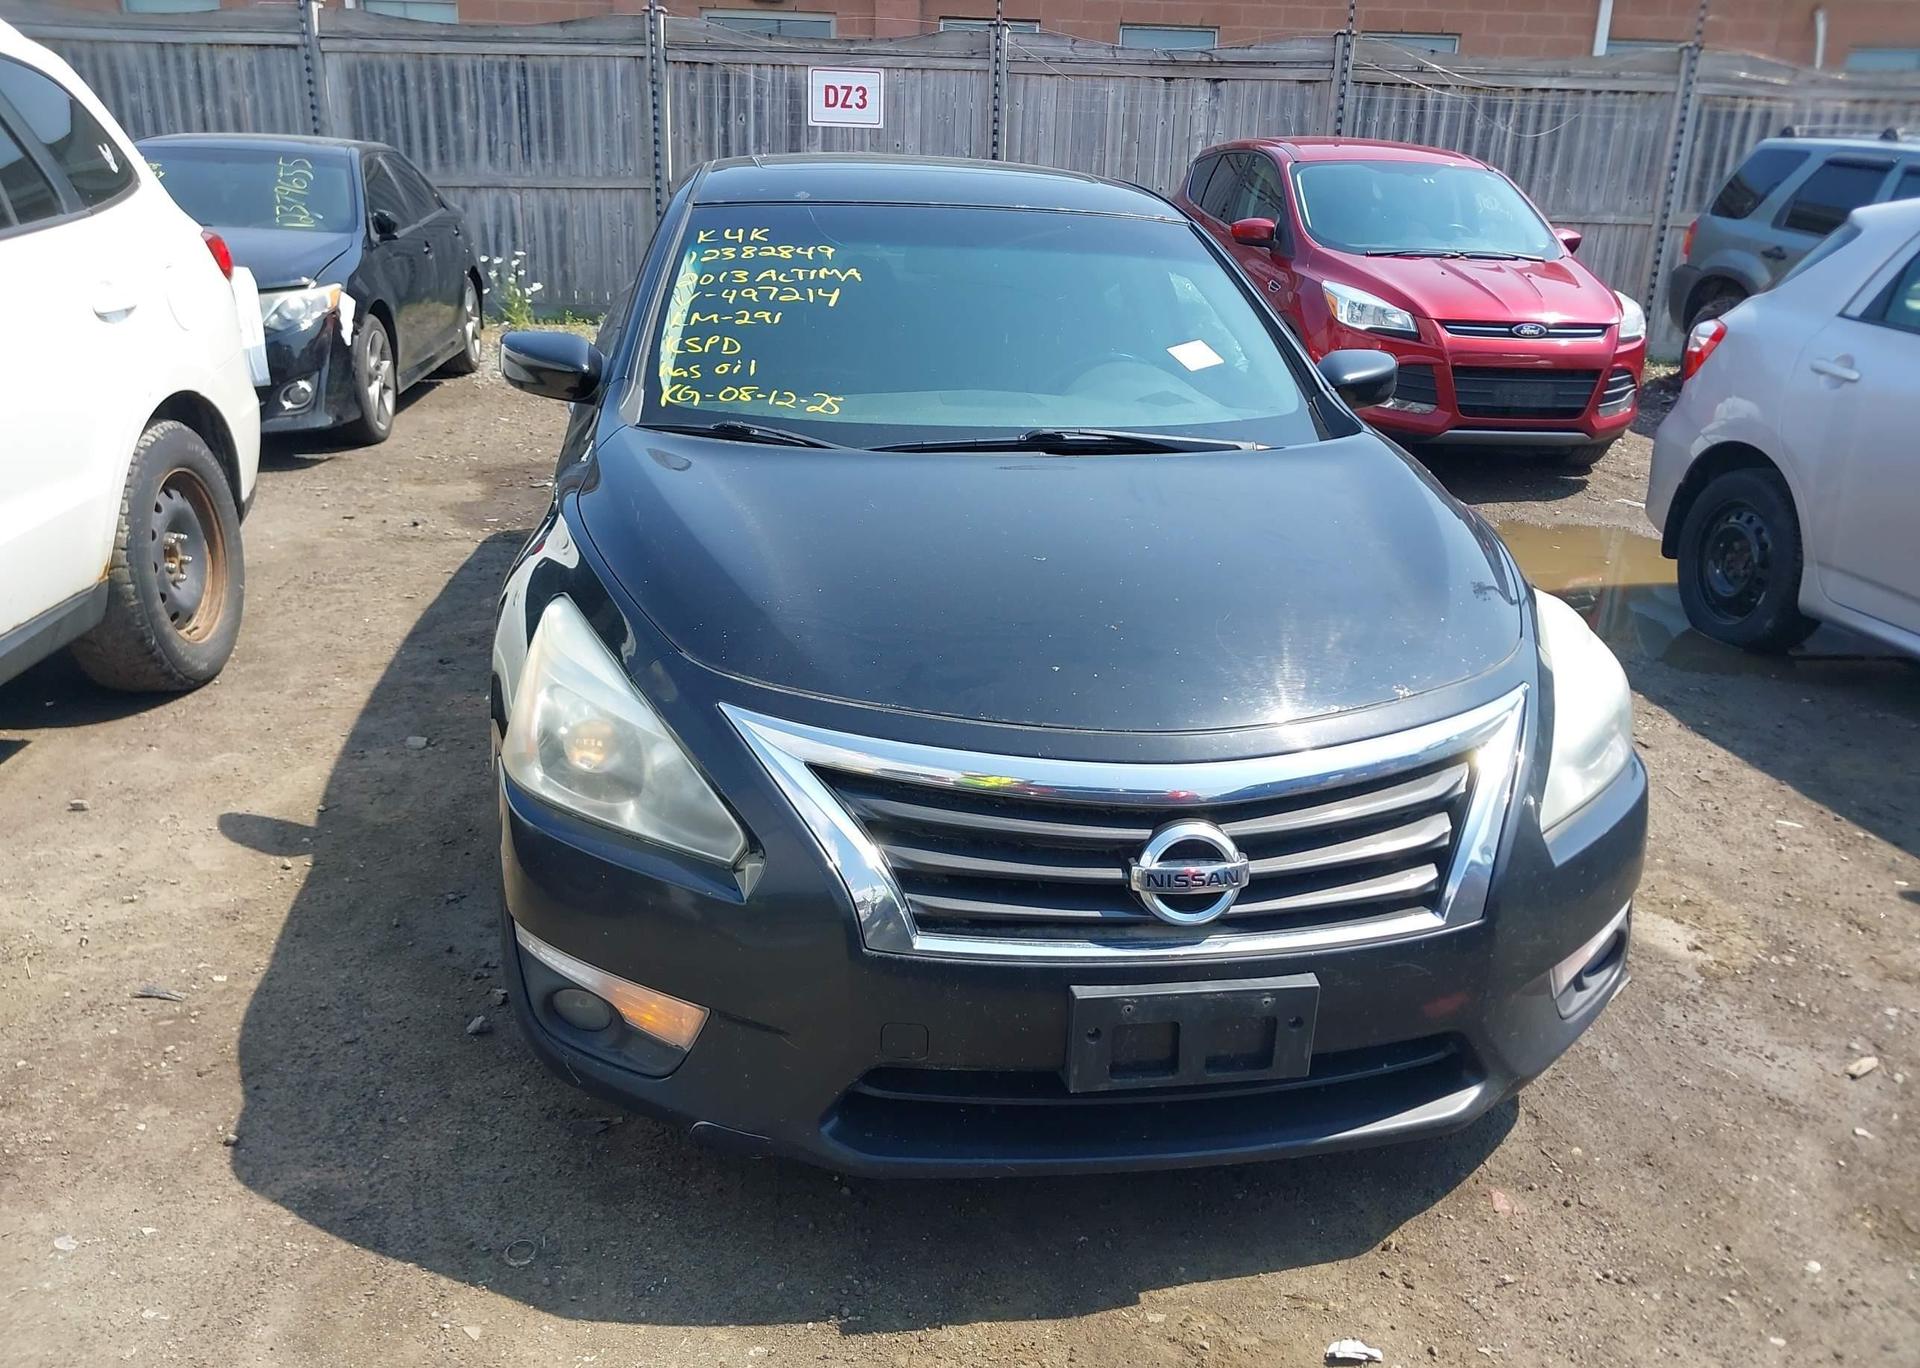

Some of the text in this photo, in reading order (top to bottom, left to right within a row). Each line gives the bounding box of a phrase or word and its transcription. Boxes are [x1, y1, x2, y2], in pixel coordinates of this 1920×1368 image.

[824, 84, 868, 110] DZ3
[689, 245, 836, 265] 12382849
[679, 270, 750, 287] 2013
[714, 359, 757, 376] oil
[1145, 869, 1240, 888] NISSAN
